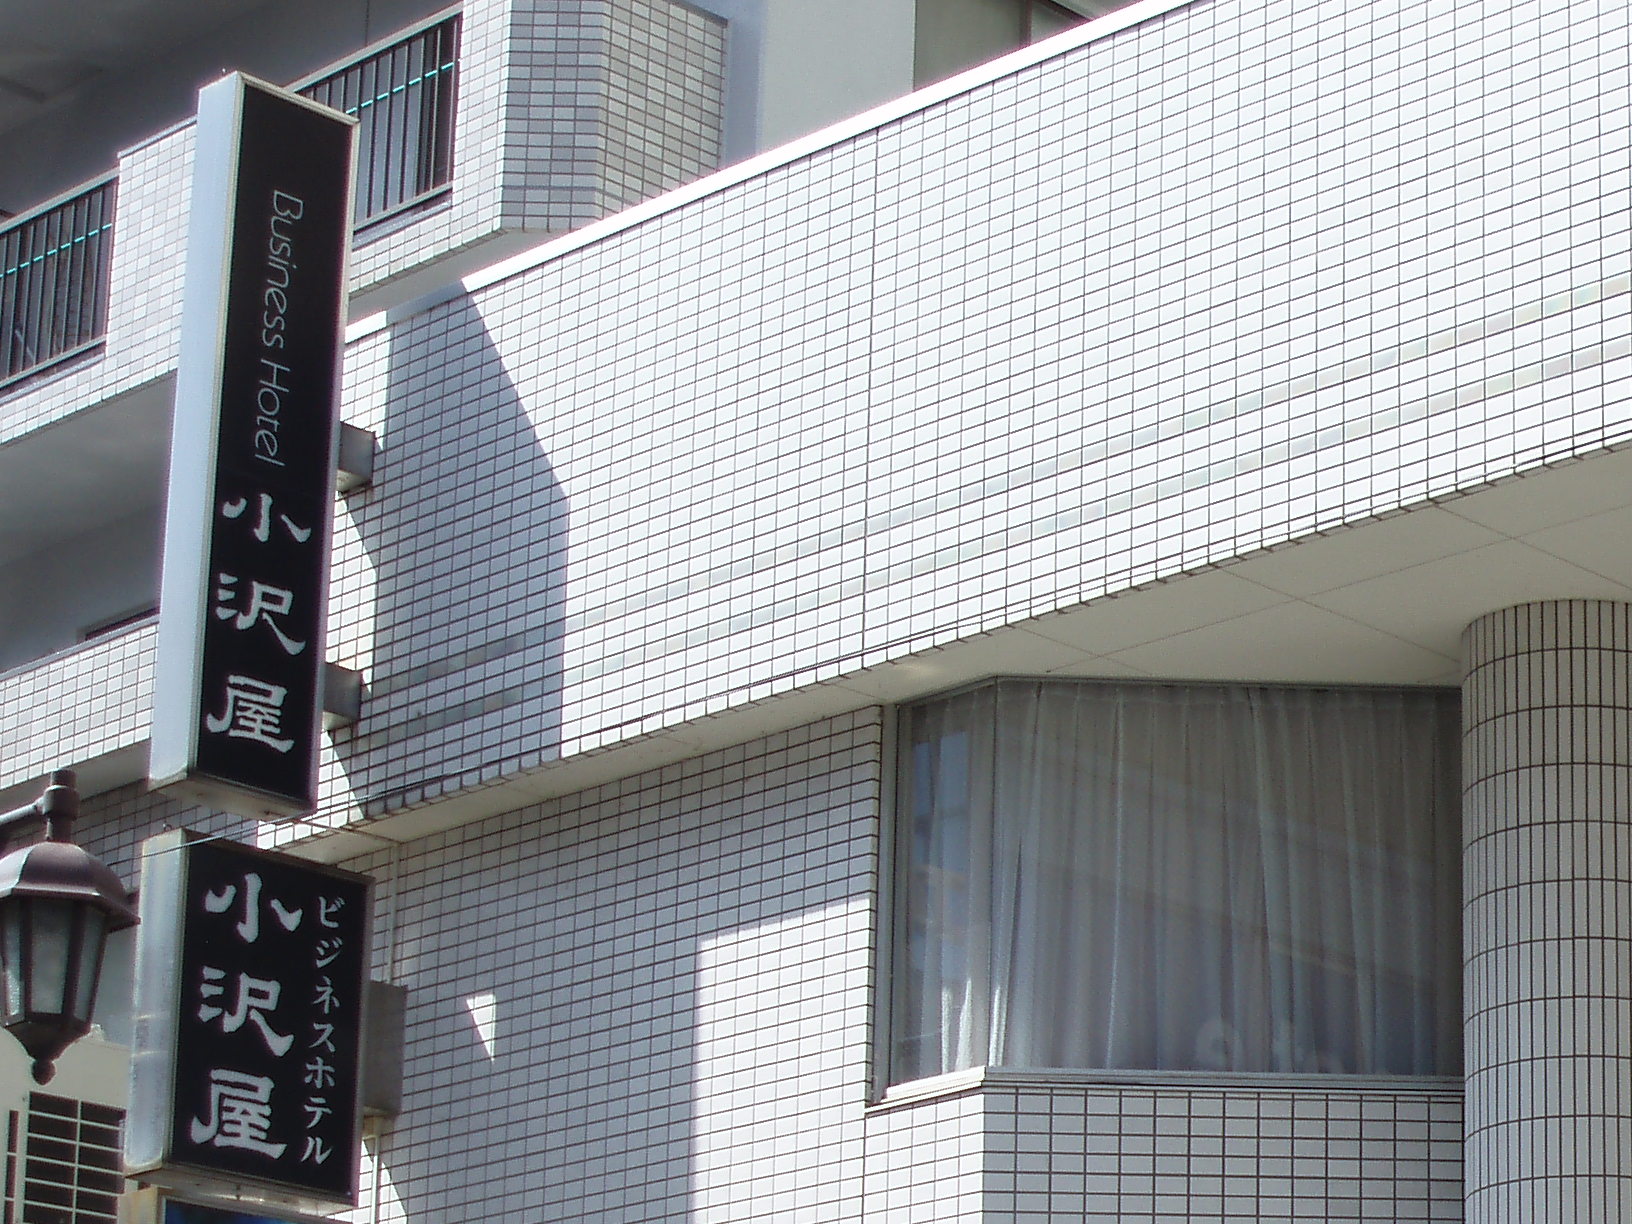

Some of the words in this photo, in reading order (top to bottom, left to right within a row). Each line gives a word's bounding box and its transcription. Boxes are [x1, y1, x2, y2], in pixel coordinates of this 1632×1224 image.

[261, 189, 303, 349] Business
[254, 359, 291, 467] Hotel
[206, 492, 311, 753] 小沢屋
[190, 872, 304, 1160] 小沢屋
[300, 895, 347, 1166] ビジネスホテル
